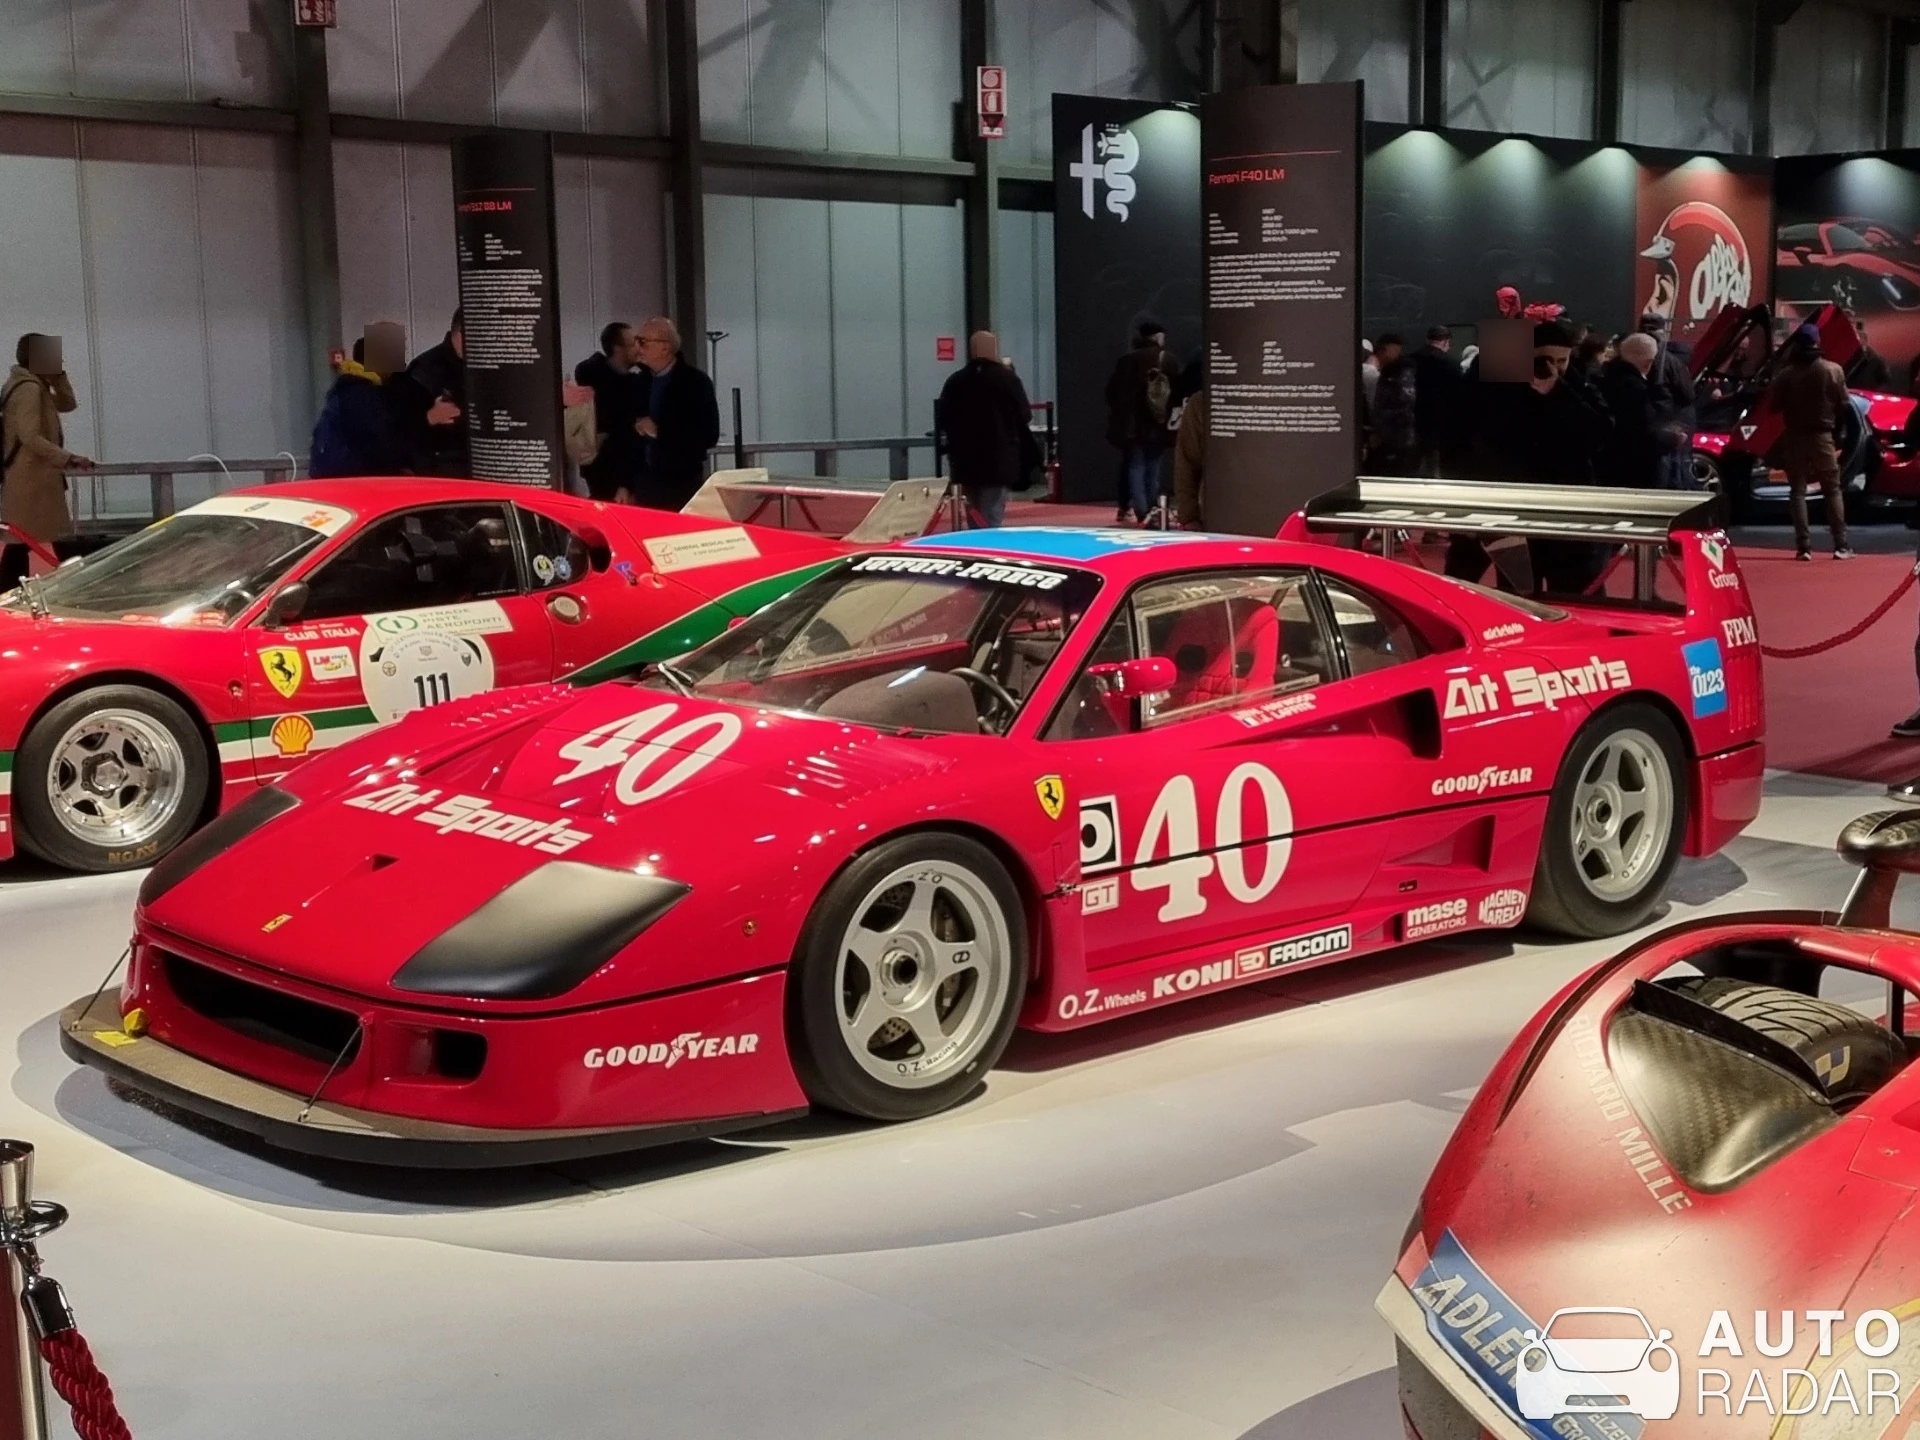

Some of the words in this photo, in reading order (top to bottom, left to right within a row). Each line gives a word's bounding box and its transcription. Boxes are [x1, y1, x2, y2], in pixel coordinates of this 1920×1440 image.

[1209, 171, 1240, 185] Ferrari
[1241, 170, 1263, 182] F40
[1265, 168, 1285, 181] LM
[497, 201, 512, 210] LM
[1708, 568, 1740, 591] Group
[418, 608, 472, 618] STRADE
[423, 614, 461, 624] PISTE
[427, 617, 502, 630] AEROPORTI
[284, 630, 320, 642] CLUB
[321, 627, 361, 639] ITALIA
[1721, 616, 1758, 649] FPM
[413, 672, 451, 708] 111
[1443, 673, 1500, 720] Art
[1503, 655, 1632, 710] Sports
[1692, 668, 1725, 699] 0123
[552, 702, 743, 806] 40
[342, 782, 443, 816] Art
[413, 794, 593, 855] Sports
[1131, 761, 1294, 923] 40
[1085, 883, 1115, 908] GT
[1407, 897, 1468, 927] mase
[1406, 915, 1468, 939] GENERATORS
[1269, 930, 1349, 966] FACOM
[1153, 959, 1234, 999] KONI
[1104, 989, 1147, 1011] Wheels
[926, 1041, 958, 1066] Racing
[1563, 1014, 1631, 1123] RICHARD
[1615, 1126, 1694, 1215] MILLE
